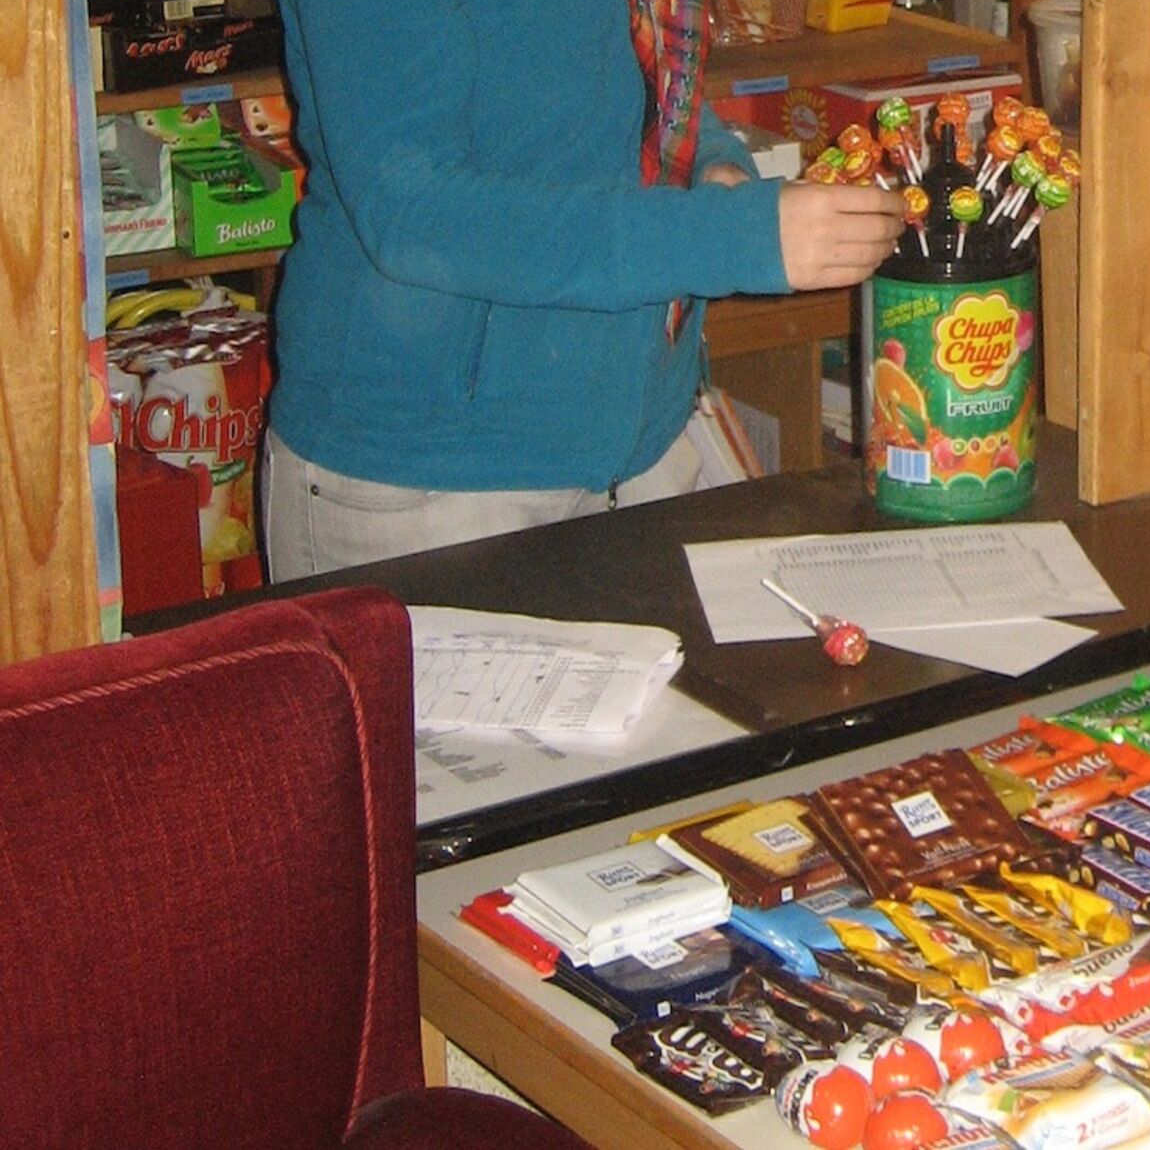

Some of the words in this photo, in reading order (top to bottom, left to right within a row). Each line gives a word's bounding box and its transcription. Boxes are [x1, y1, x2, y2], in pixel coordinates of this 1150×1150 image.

[186, 43, 233, 70] Mars
[216, 216, 276, 245] Balisto
[949, 317, 1014, 341] Chupa
[945, 339, 1012, 377] Chups
[138, 396, 263, 463] Chips
[909, 810, 942, 828] SPORT
